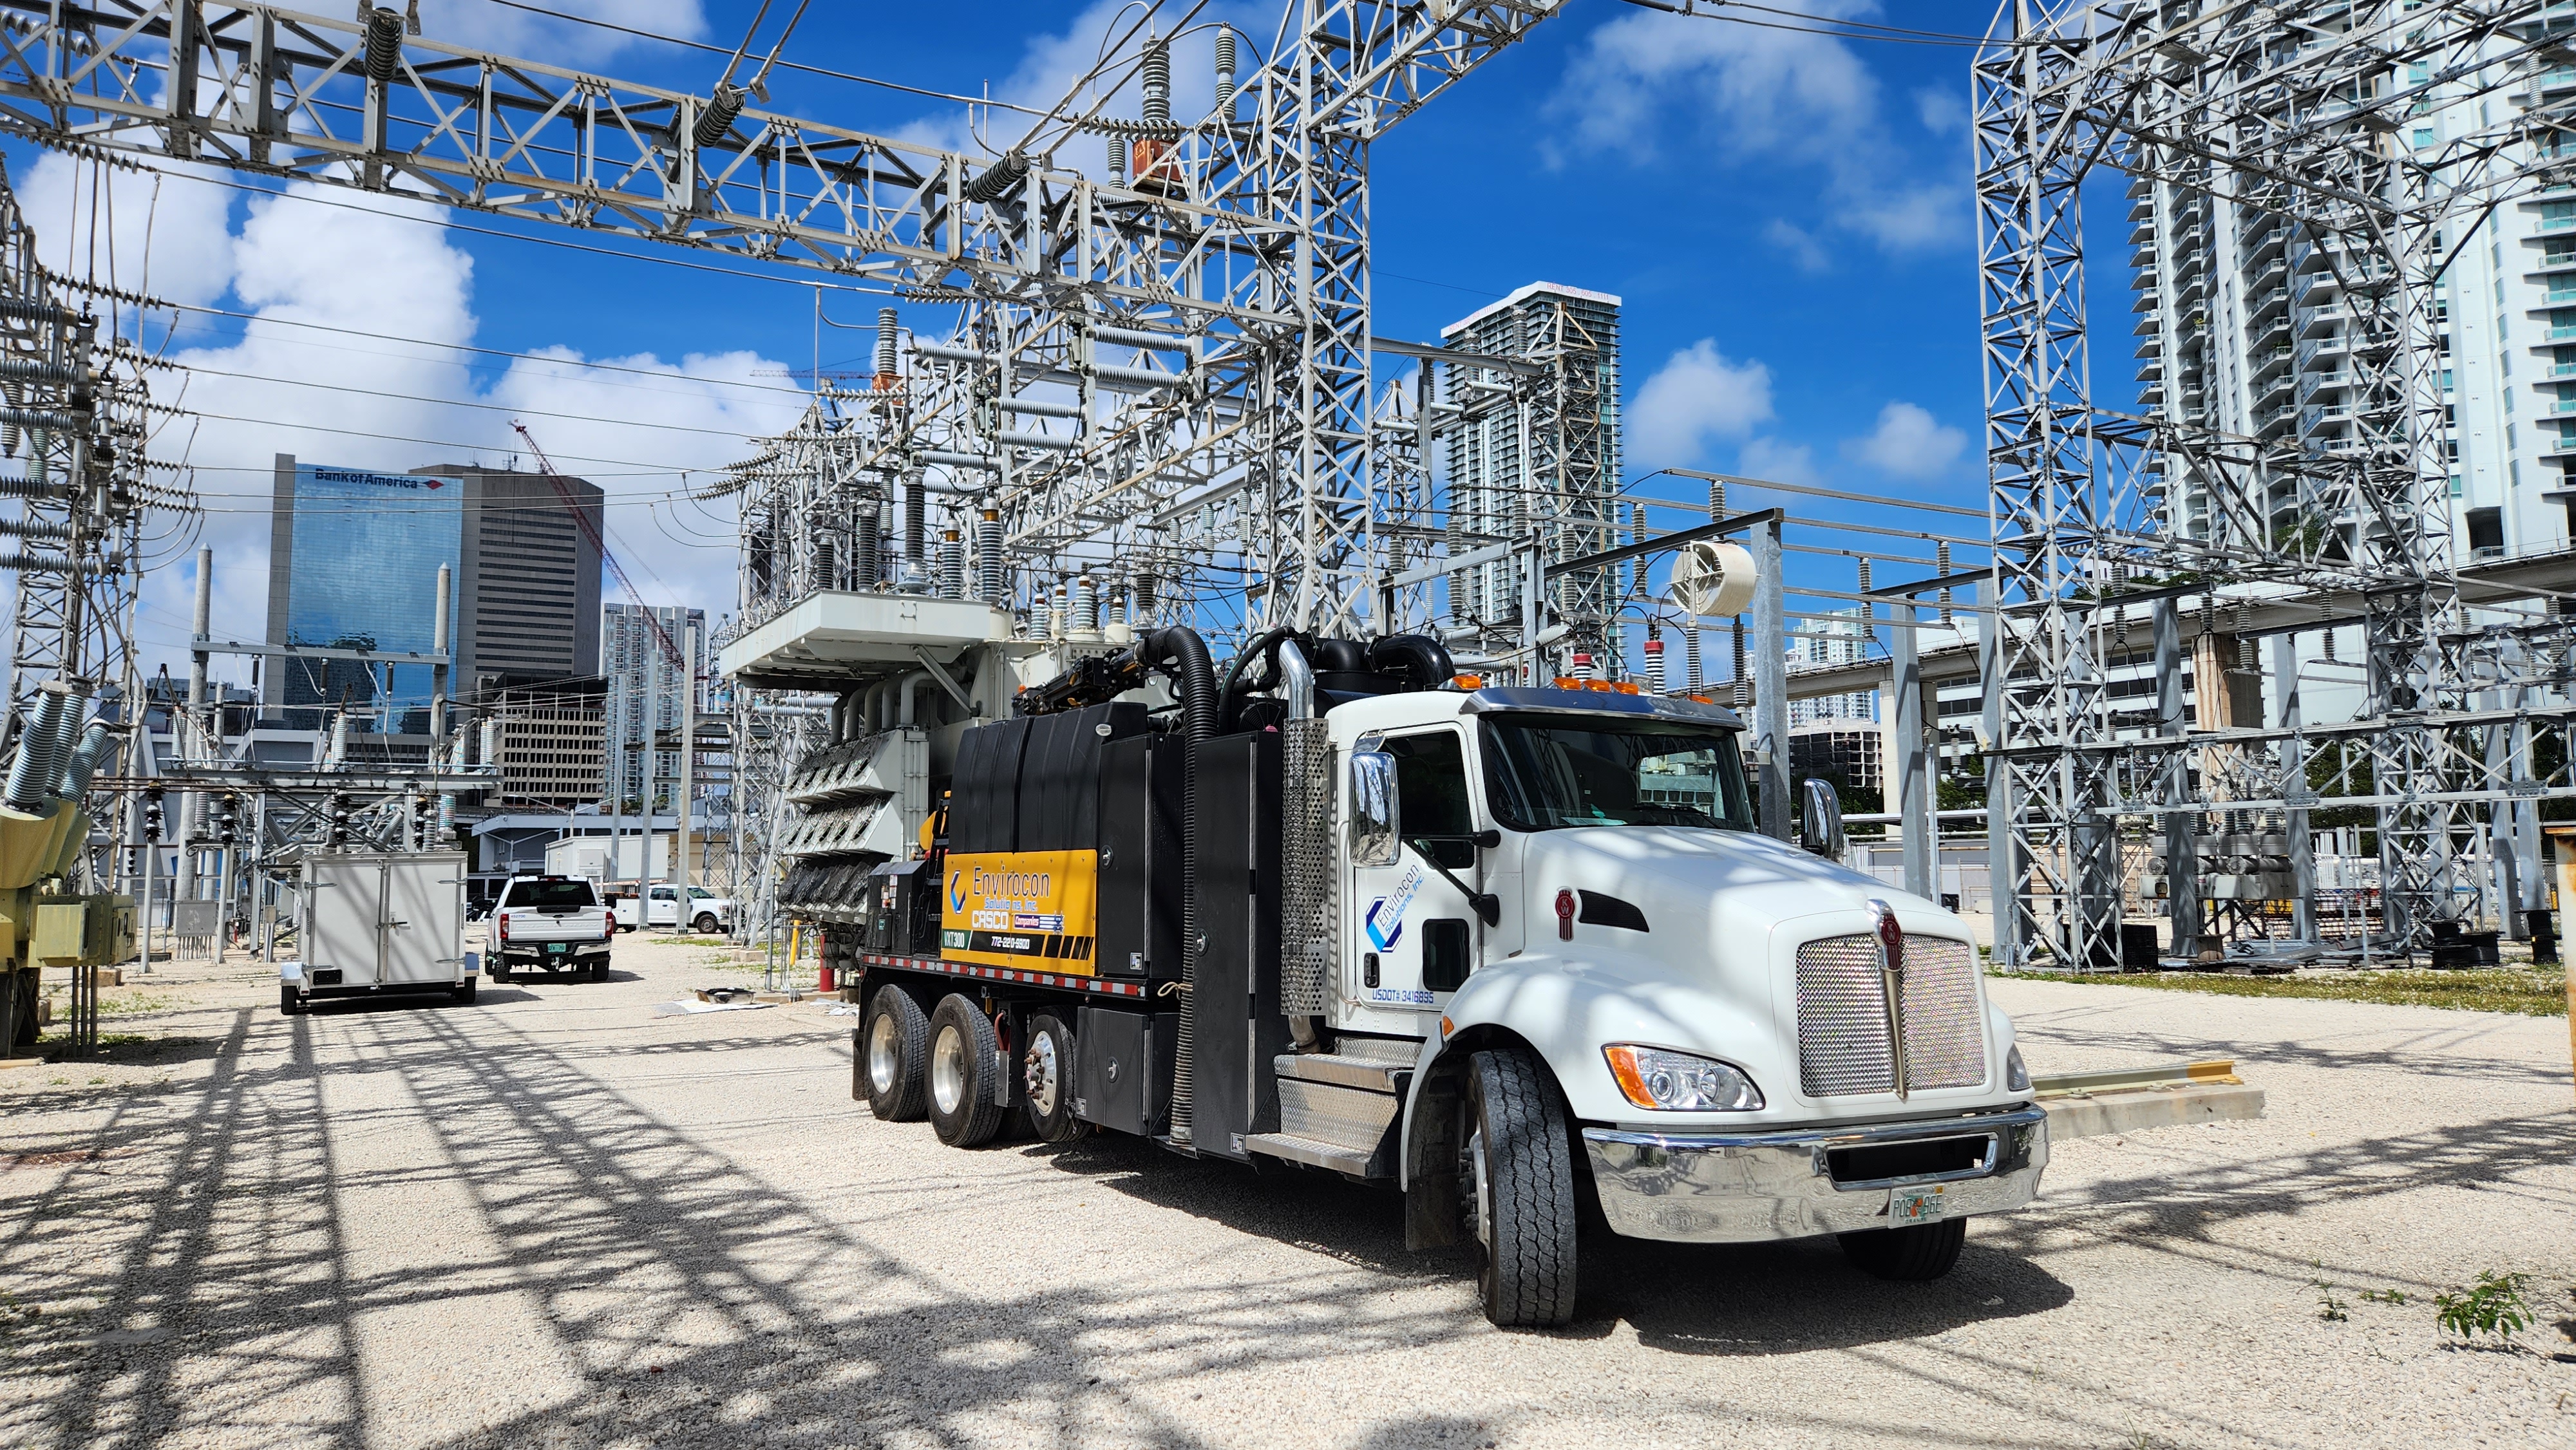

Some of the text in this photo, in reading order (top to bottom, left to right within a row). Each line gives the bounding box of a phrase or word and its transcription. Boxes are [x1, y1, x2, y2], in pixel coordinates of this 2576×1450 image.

[1547, 283, 1563, 292] RENT
[316, 468, 418, 489] Bank of America
[974, 865, 1050, 898] Envirocon
[1377, 864, 1419, 927] Envirocon
[1025, 899, 1037, 912] Inc.
[1385, 876, 1425, 935] Solutions, Inc.
[972, 910, 1039, 930] CASCO Companies
[944, 931, 965, 948] VXT300
[990, 936, 1030, 950] 772-220-9900
[1372, 989, 1434, 1004] USDOT# 3416895
